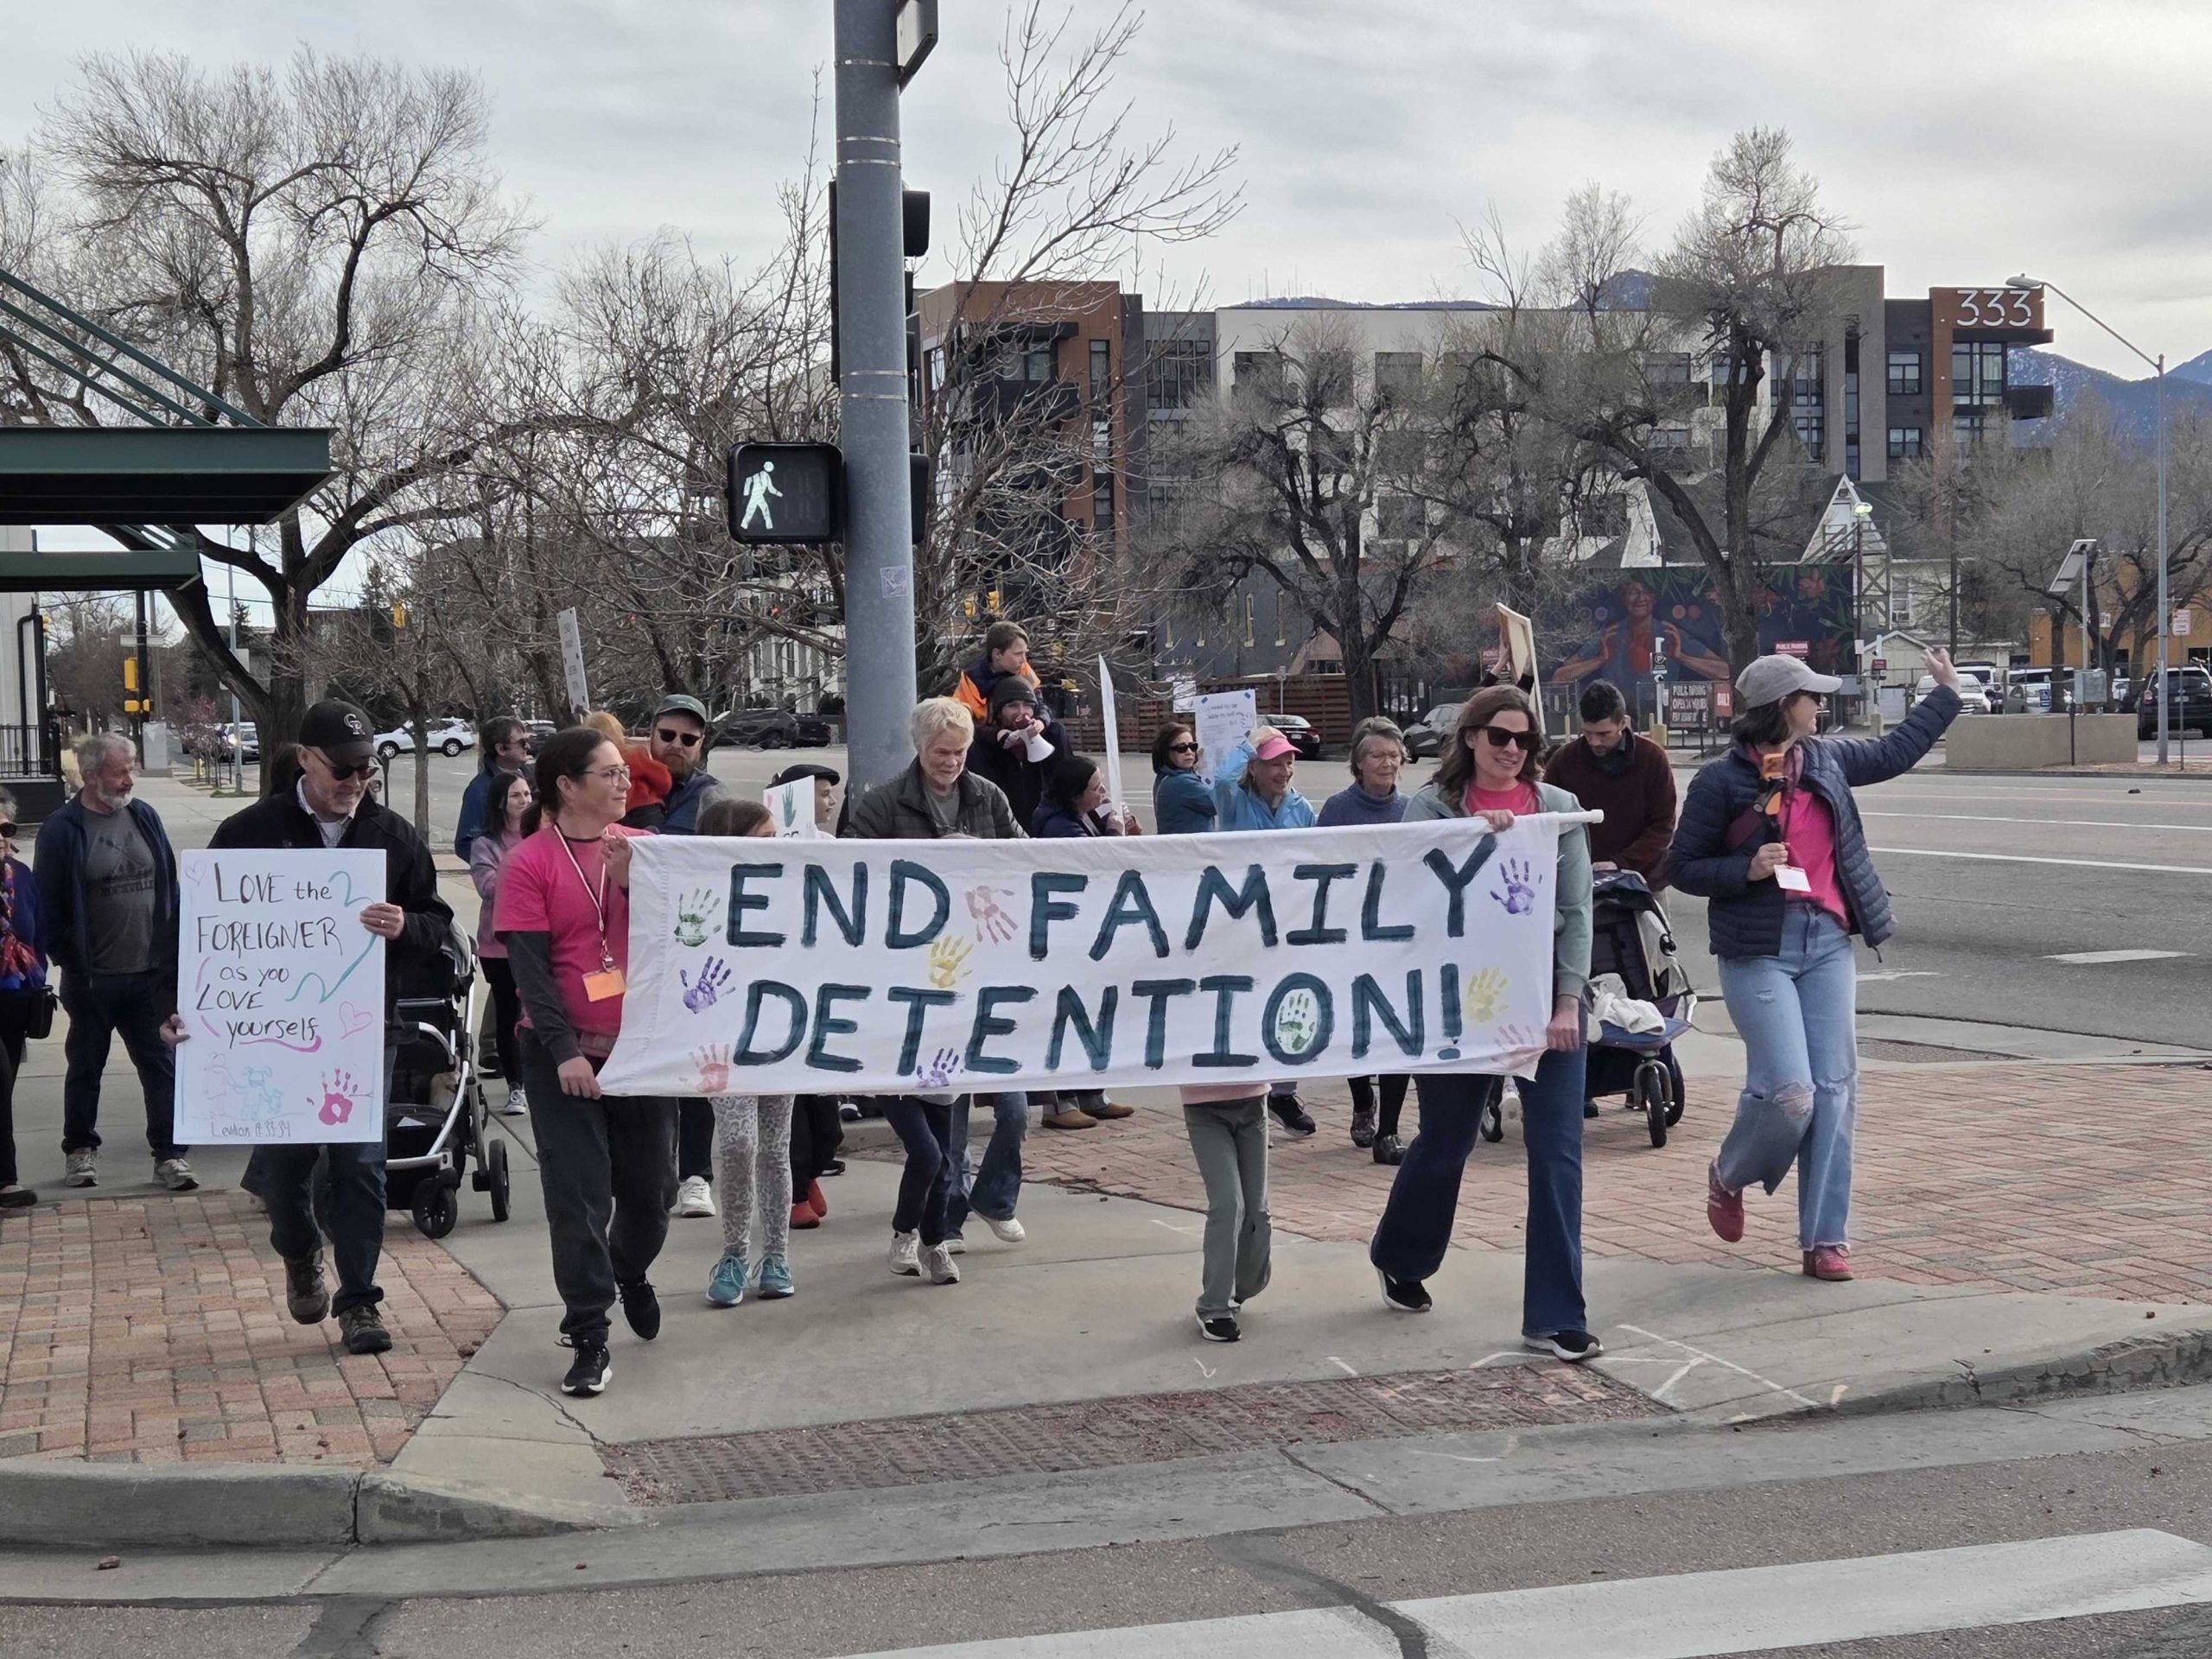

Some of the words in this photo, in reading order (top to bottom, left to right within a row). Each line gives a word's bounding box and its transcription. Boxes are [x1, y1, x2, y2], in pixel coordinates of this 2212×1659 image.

[1956, 289, 2031, 326] 333
[215, 862, 286, 904] LOVE
[294, 881, 333, 900] the
[727, 859, 950, 949] END
[1029, 834, 1497, 961] FAMILY
[198, 915, 343, 959] FOREIGNER
[219, 967, 249, 982] as
[257, 967, 290, 988] you
[196, 983, 264, 1012] LOVE
[226, 1017, 319, 1050] yourself
[733, 962, 1464, 1076] DETENTION!
